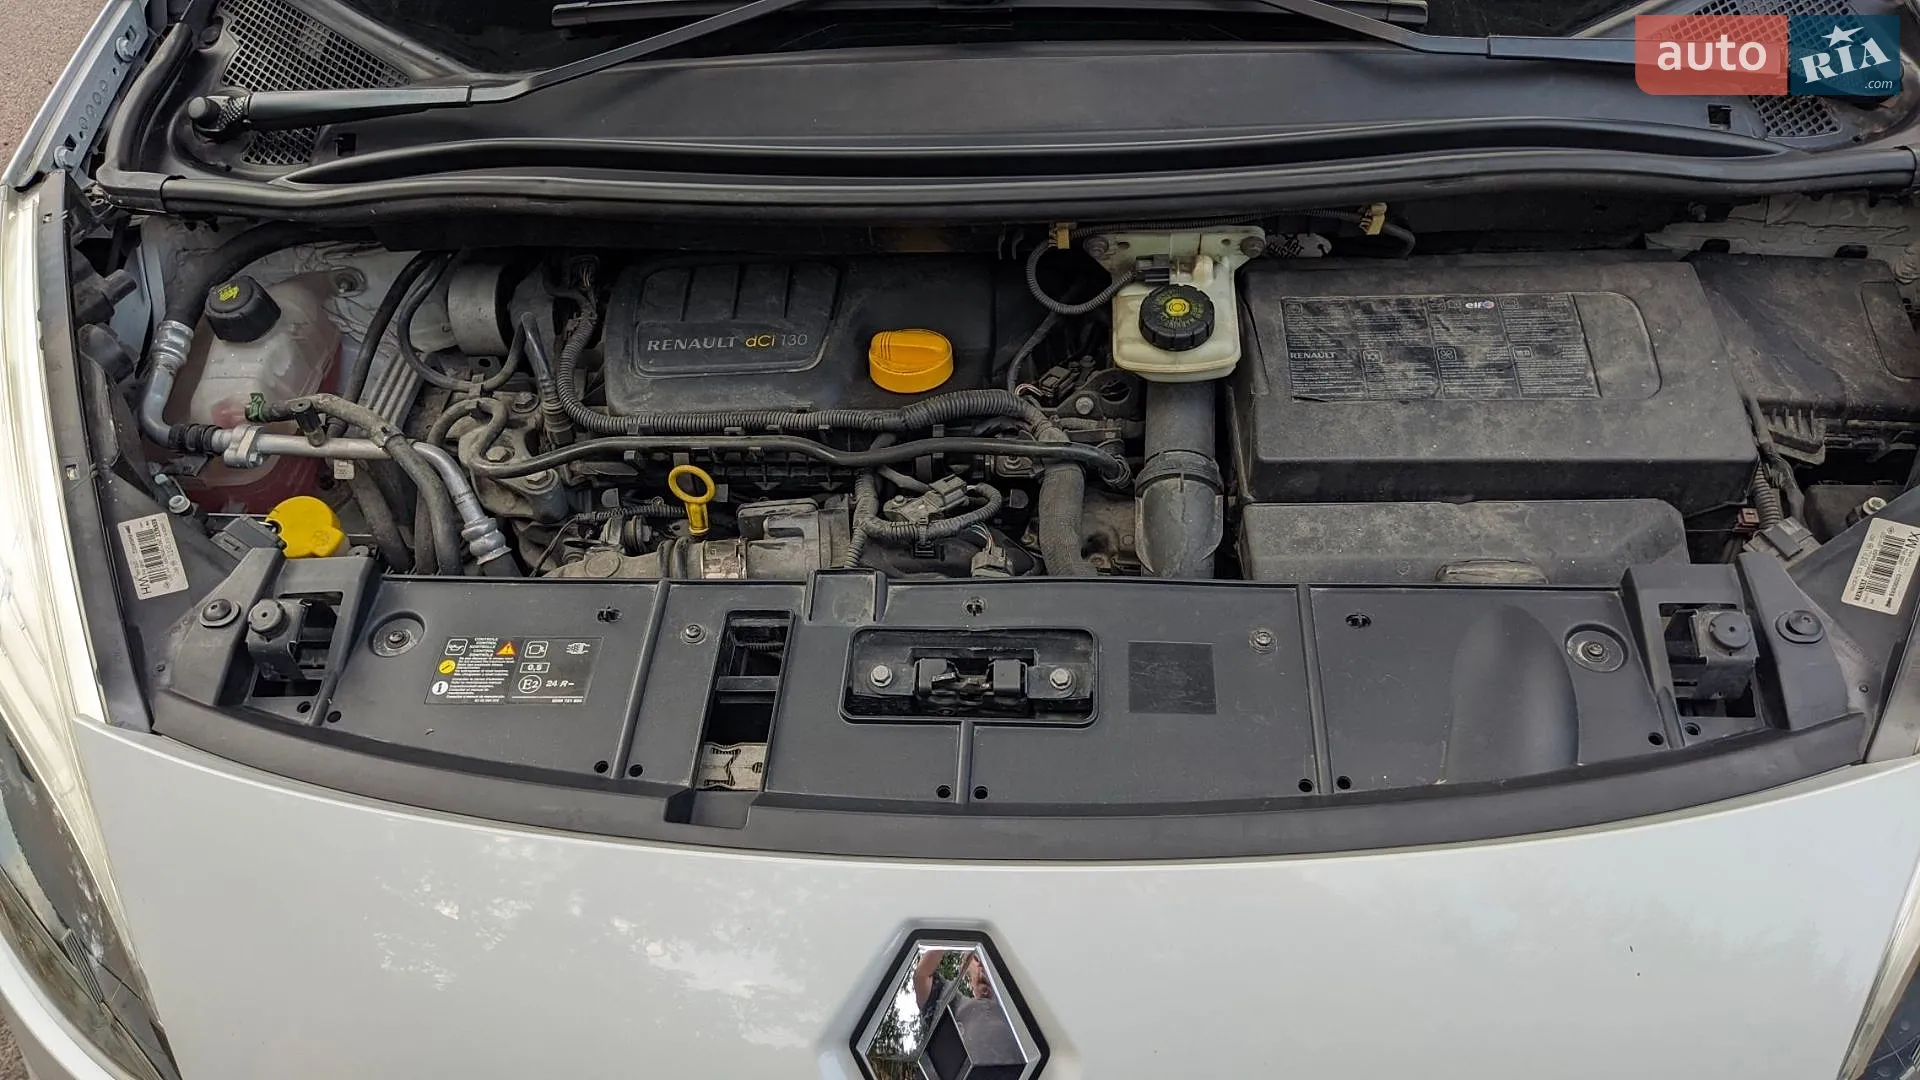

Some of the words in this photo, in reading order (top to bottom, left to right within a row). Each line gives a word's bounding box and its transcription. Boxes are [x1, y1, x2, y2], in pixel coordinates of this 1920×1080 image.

[647, 335, 738, 351] RENAULT
[745, 335, 776, 348] dCi
[781, 334, 808, 346] 130
[1290, 351, 1337, 359] RENAULT
[521, 679, 539, 690] E2
